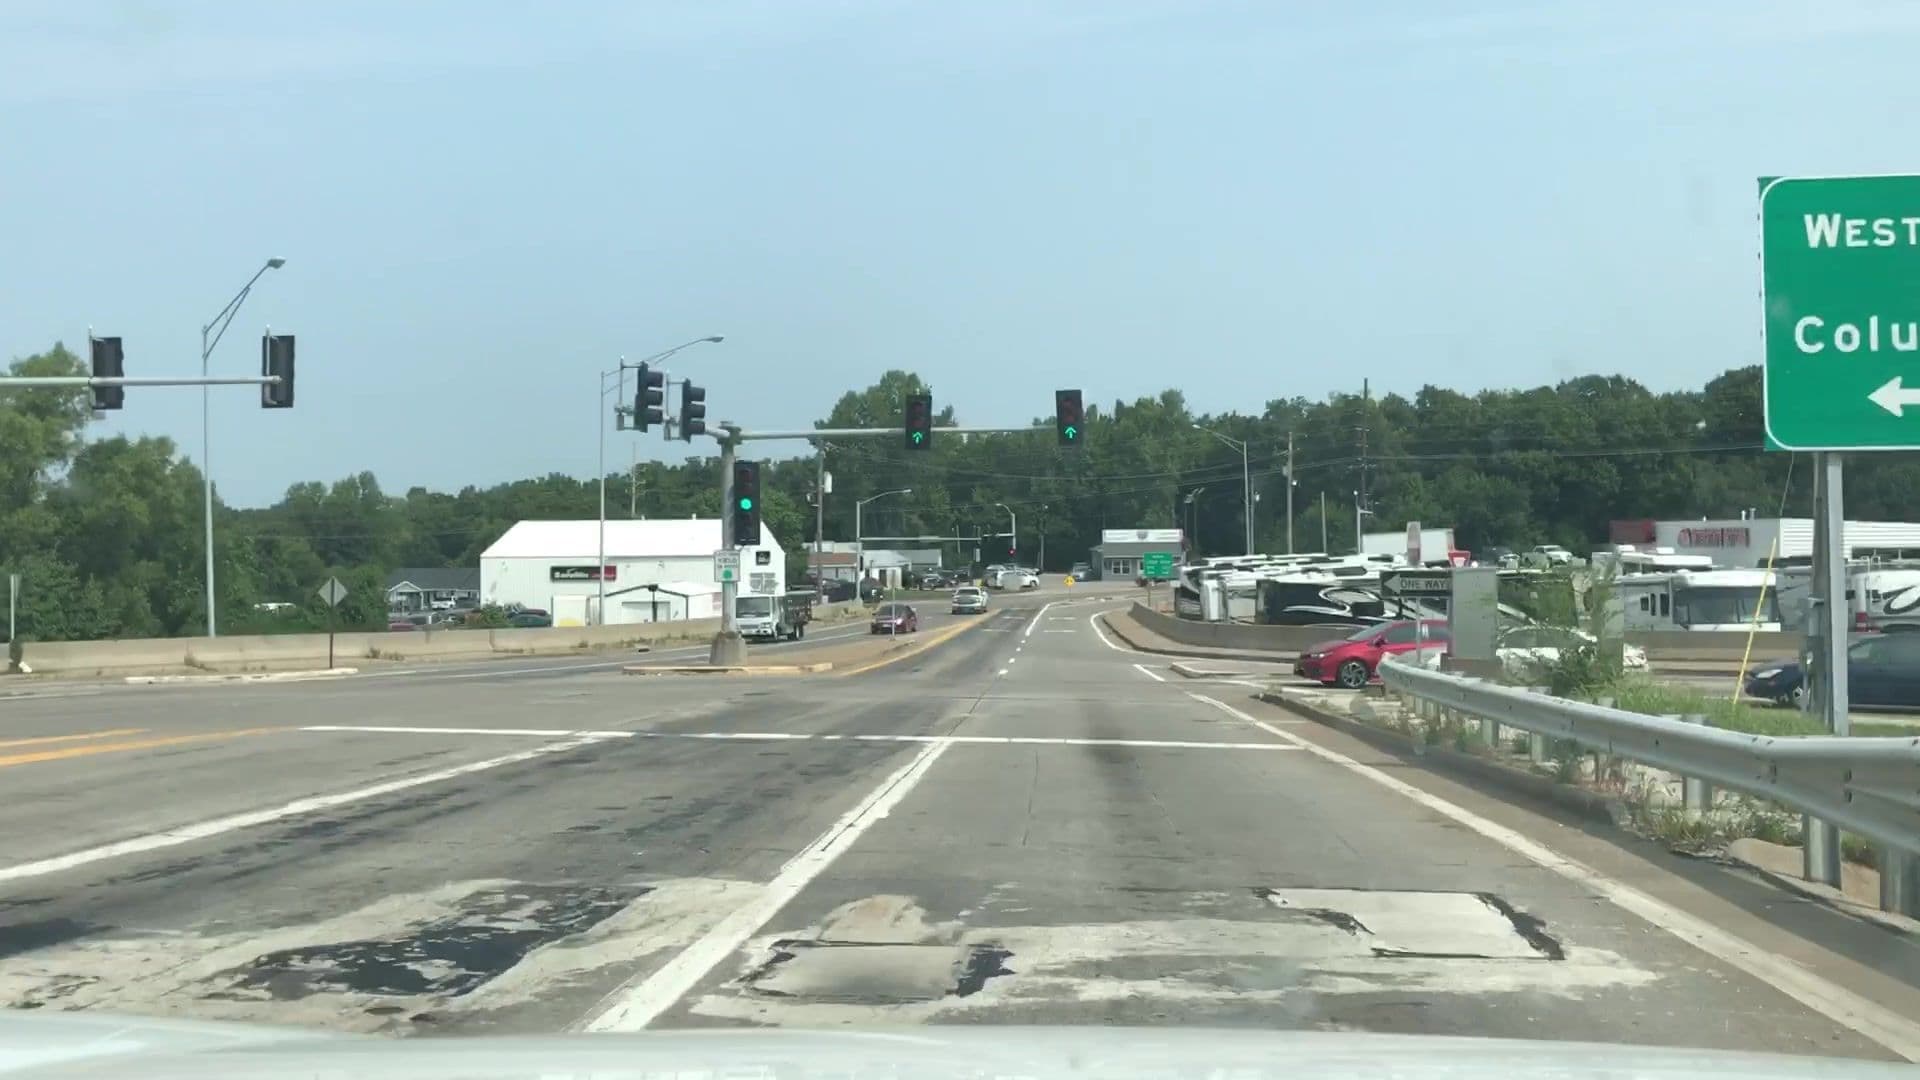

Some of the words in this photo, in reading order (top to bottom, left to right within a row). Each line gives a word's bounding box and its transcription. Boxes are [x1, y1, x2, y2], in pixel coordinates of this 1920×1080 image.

[1804, 213, 1920, 248] WEST
[1794, 315, 1918, 353] Colu
[1401, 580, 1420, 589] ONE
[1425, 580, 1446, 589] WAY
